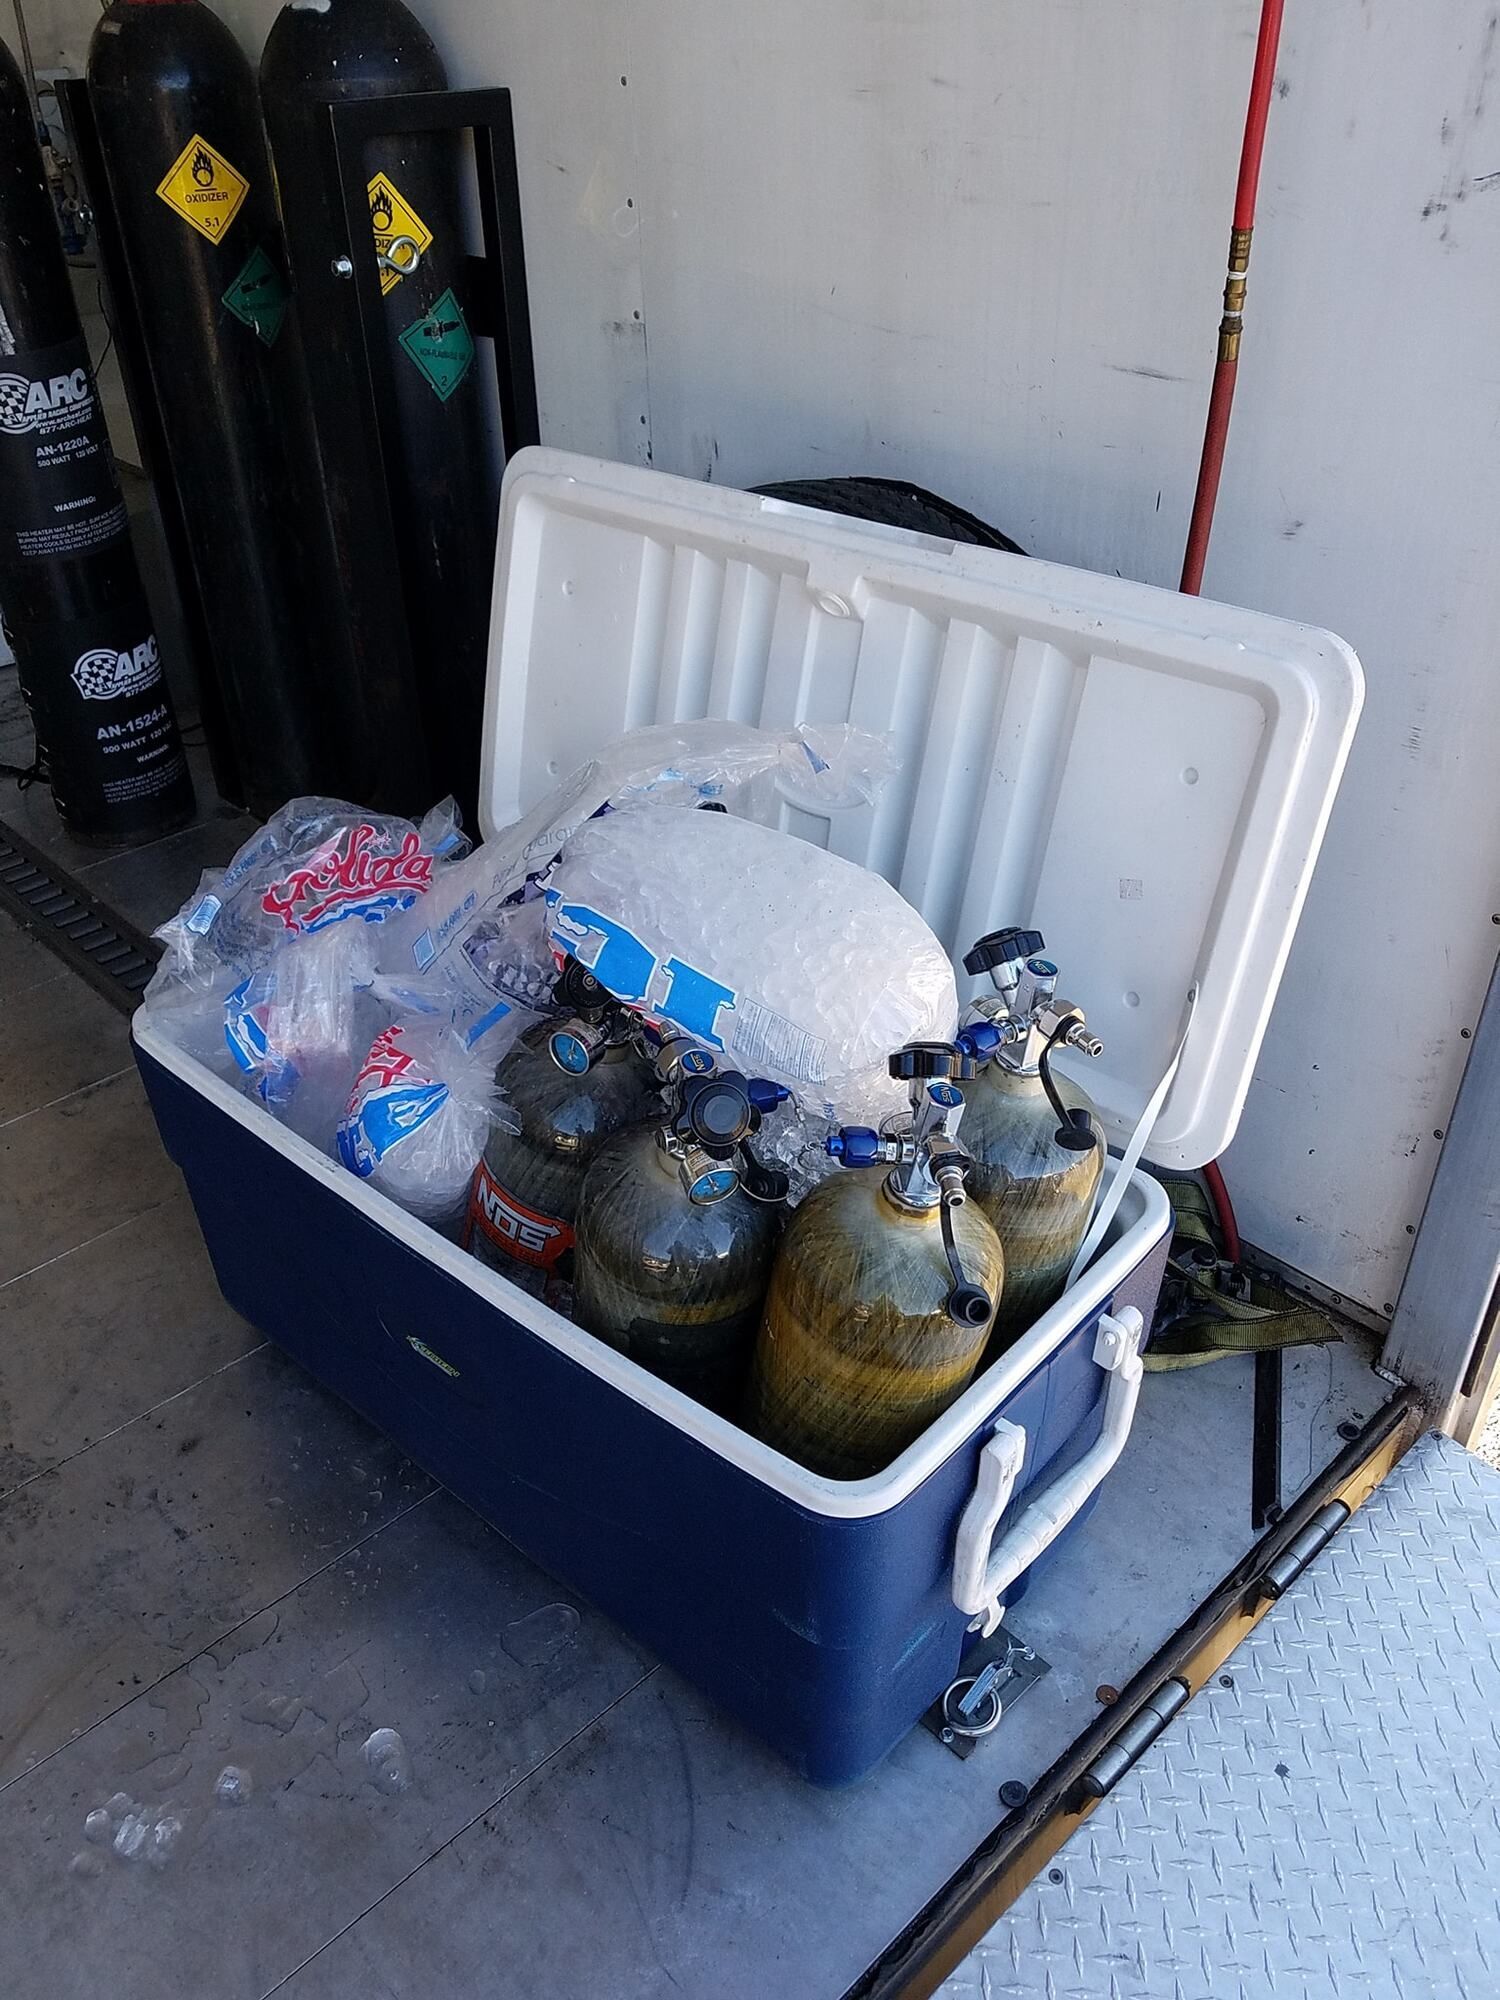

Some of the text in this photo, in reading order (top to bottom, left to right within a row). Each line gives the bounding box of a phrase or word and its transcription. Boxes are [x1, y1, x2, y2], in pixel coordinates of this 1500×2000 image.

[184, 191, 229, 204] OXIDIZER
[204, 217, 220, 228] 5.1
[441, 375, 448, 386] 2
[24, 368, 88, 414] ARC
[36, 435, 90, 457] AN-1220A
[51, 454, 71, 465] WATT
[54, 496, 97, 512] WARNING:
[114, 634, 157, 681] ARC
[97, 703, 167, 740] AN-1524-A
[102, 744, 120, 754] 900
[121, 736, 147, 751] WATT
[690, 1053, 706, 1071] NOS
[477, 1173, 561, 1253] NOS
